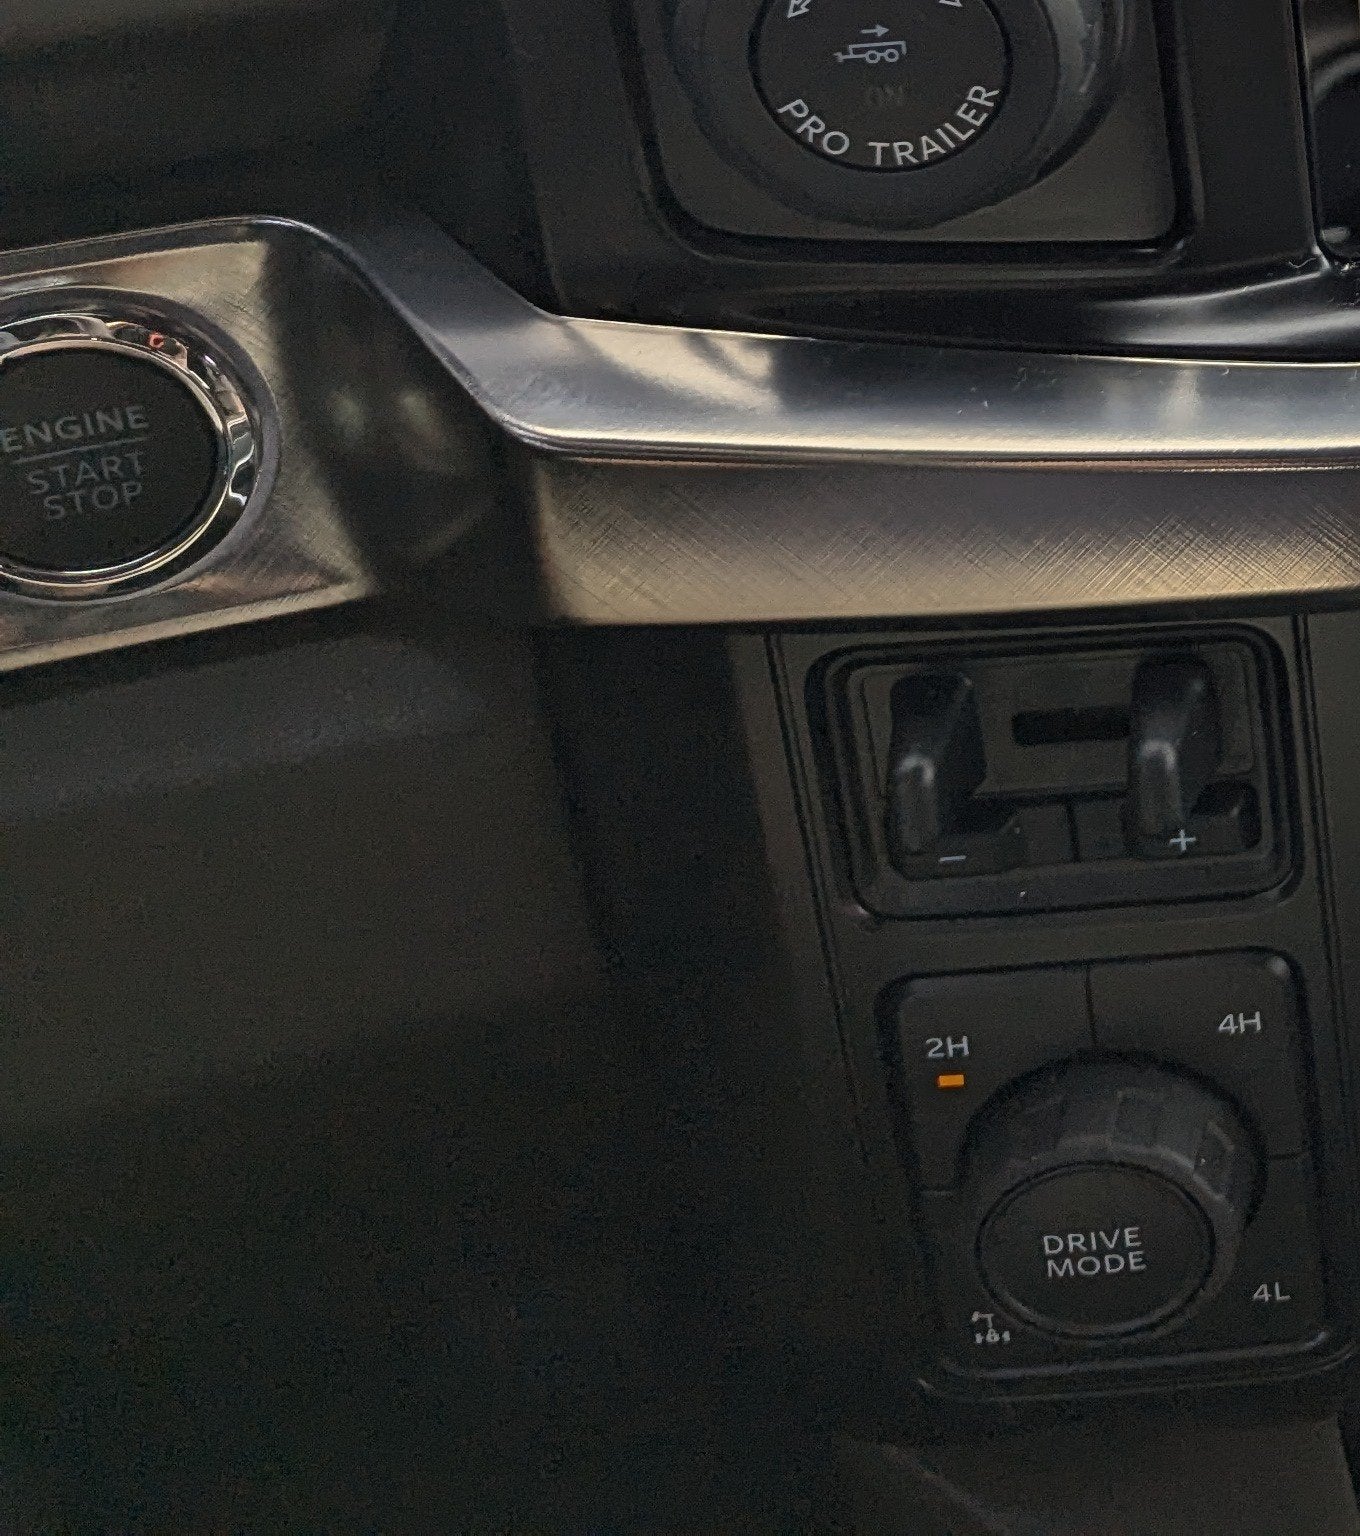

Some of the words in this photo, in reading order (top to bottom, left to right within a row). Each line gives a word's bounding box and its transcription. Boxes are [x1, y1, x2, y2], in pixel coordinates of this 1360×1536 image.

[777, 98, 850, 155] PRO
[868, 84, 1000, 166] TRAILER
[0, 406, 150, 452] ENGINE
[28, 452, 146, 495] START
[44, 482, 143, 519] STOP
[1217, 1011, 1262, 1035] 4H
[925, 1035, 969, 1059] 2H
[1042, 1227, 1142, 1256] DRIVE
[1047, 1250, 1147, 1279] MODE
[1252, 1280, 1291, 1302] 4L
